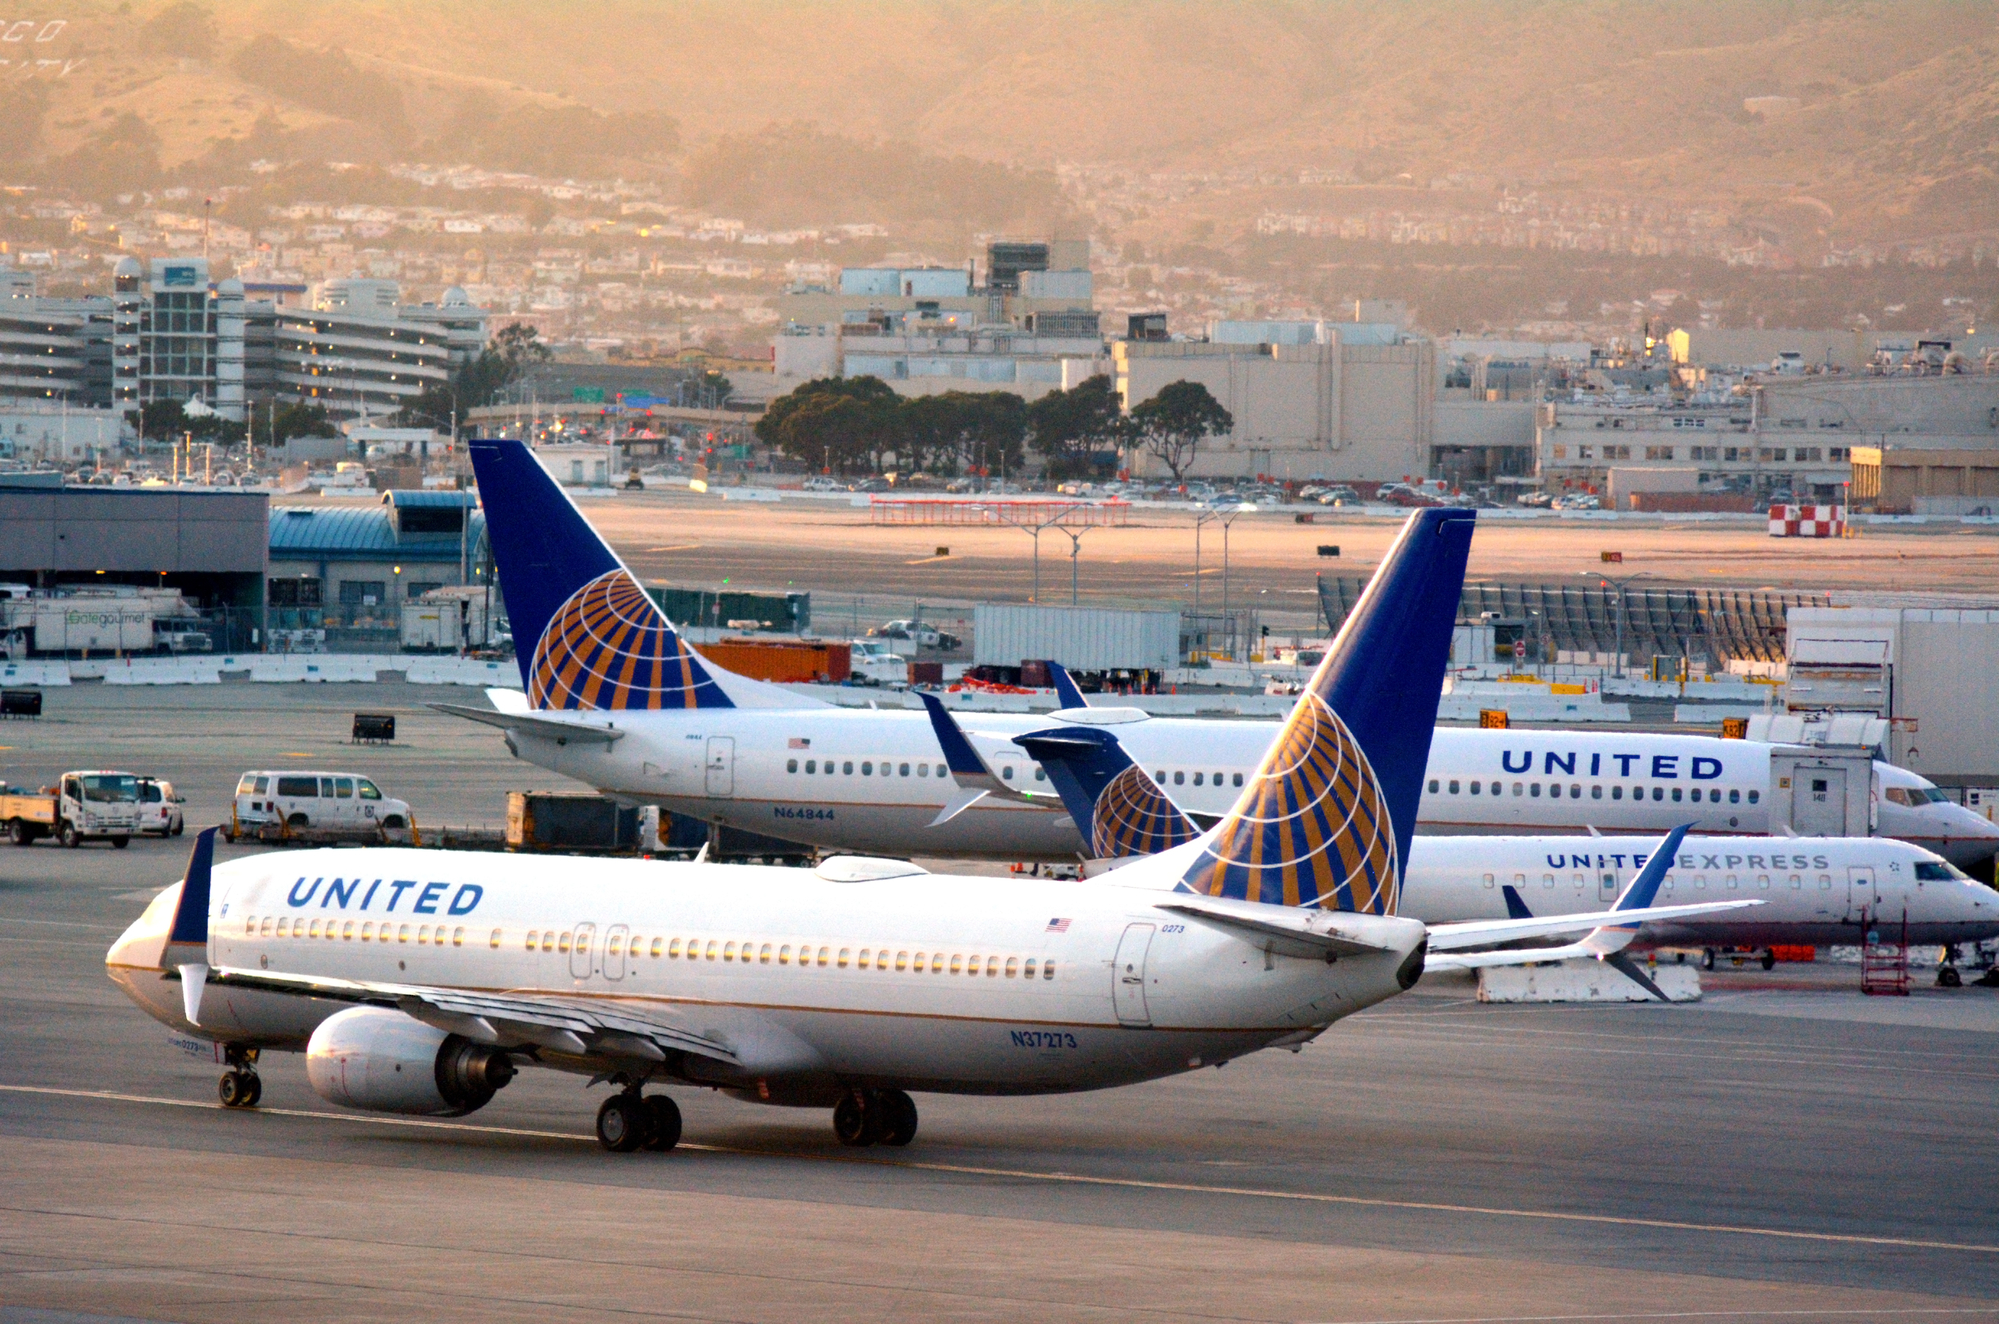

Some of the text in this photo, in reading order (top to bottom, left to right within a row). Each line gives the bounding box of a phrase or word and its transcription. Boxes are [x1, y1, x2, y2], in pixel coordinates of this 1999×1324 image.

[0, 20, 67, 42] CO
[1502, 750, 1723, 780] UNITED
[774, 807, 835, 821] N64844
[1547, 854, 1829, 870] UNITE EXPRESS
[287, 877, 484, 916] UNITED
[1161, 924, 1186, 934] 0273
[1011, 1030, 1078, 1049] N37273
